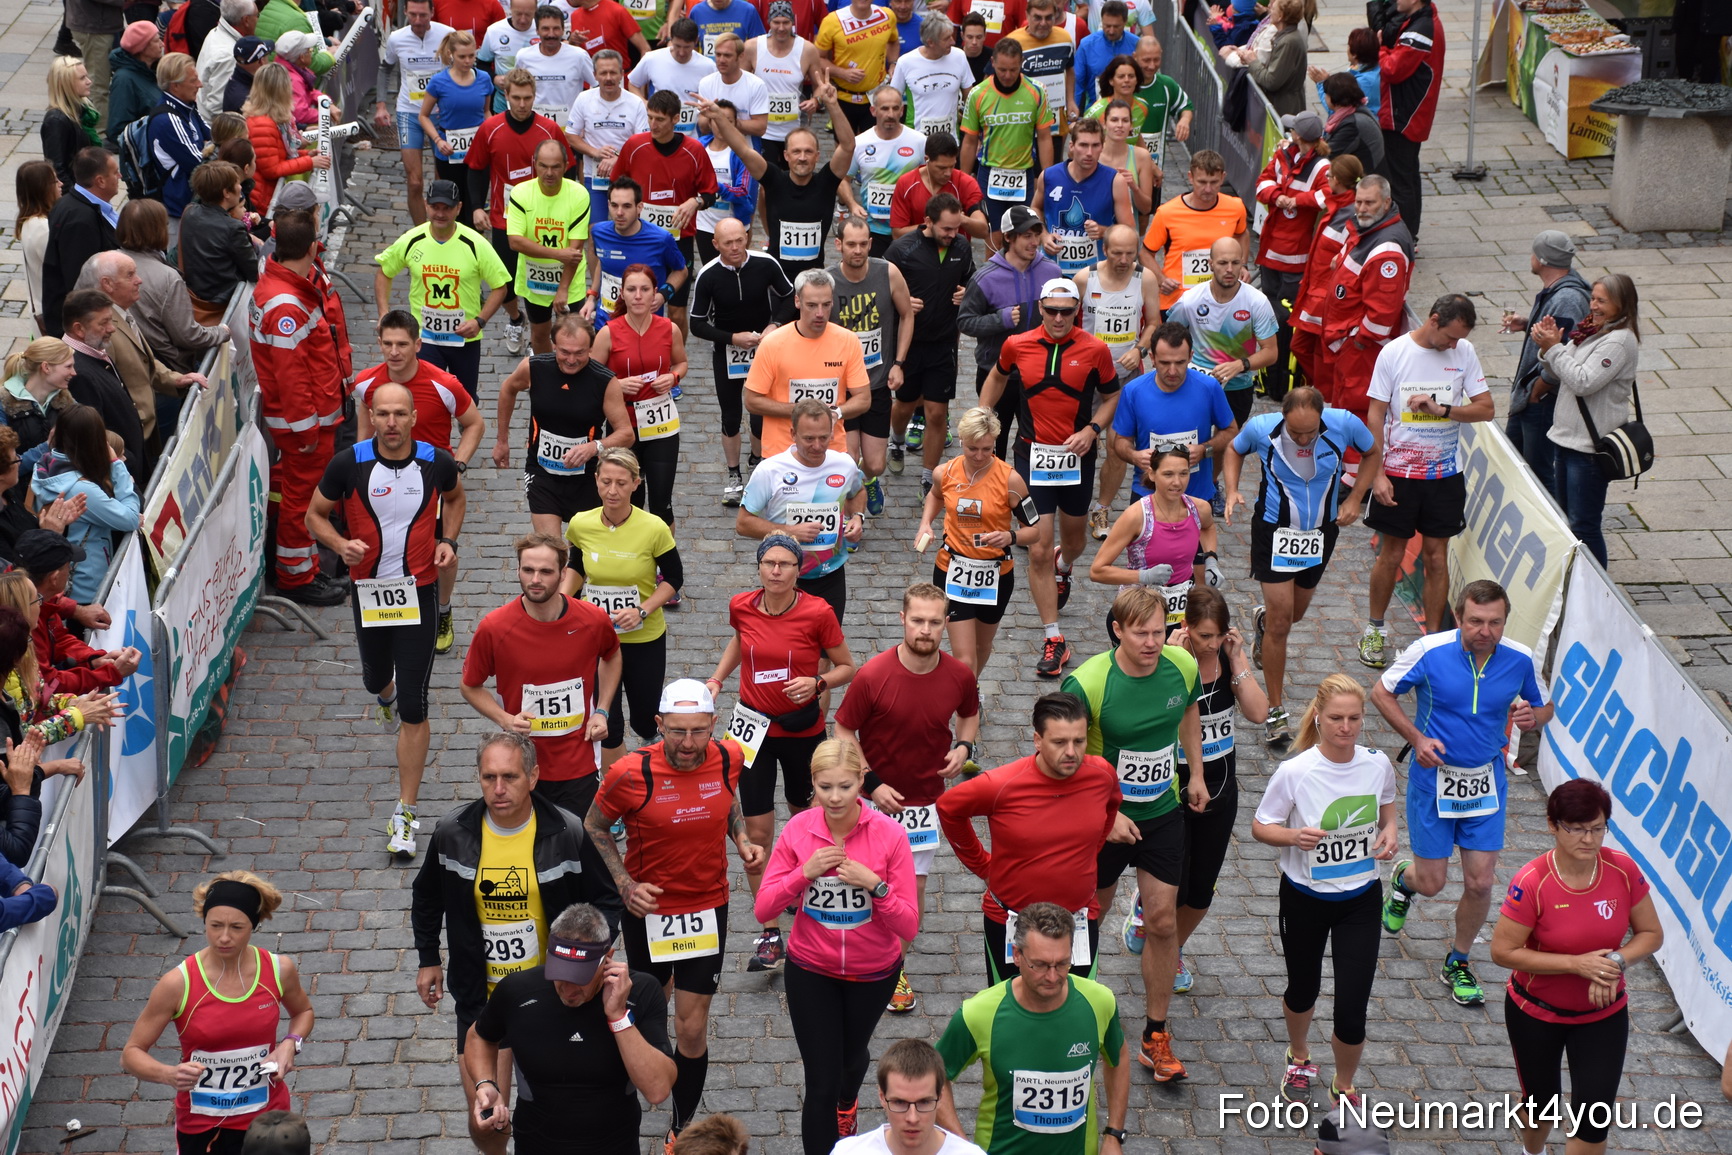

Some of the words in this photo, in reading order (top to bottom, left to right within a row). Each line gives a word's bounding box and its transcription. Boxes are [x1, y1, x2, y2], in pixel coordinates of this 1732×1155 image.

[846, 32, 868, 45] MAX
[870, 24, 891, 37] BÖGL
[1029, 58, 1063, 69] Fischer
[769, 100, 792, 113] 239
[320, 114, 330, 141] BMW
[451, 137, 472, 151] 204
[992, 173, 1023, 188] 2792
[871, 192, 893, 205] 227
[1049, 186, 1063, 202] 4
[535, 217, 565, 227] Müller
[648, 213, 673, 228] 289
[783, 230, 818, 246] 3111
[1061, 243, 1094, 260] 2092
[421, 263, 460, 275] Müller
[529, 268, 562, 284] 2390
[431, 283, 451, 299] M
[838, 282, 877, 305] RUN
[839, 302, 880, 323] THIS
[424, 316, 461, 332] 2818
[1104, 318, 1130, 332] 161
[731, 339, 756, 353] 224
[794, 378, 834, 394] 2529
[646, 404, 673, 425] 317
[1412, 413, 1442, 421] Matthias
[657, 426, 668, 434] Eva
[1036, 453, 1077, 469] 2570
[1047, 472, 1064, 480] Sven
[373, 486, 387, 494] tkn
[1278, 536, 1321, 556] 2626
[1287, 557, 1308, 567] Oliver
[952, 566, 996, 587] 2198
[371, 588, 407, 607] 103
[587, 588, 602, 596] PARTL
[960, 588, 981, 598] Maria
[592, 597, 636, 616] 2165
[378, 610, 403, 620] Henrik
[762, 672, 779, 680] DEHN
[544, 685, 574, 696] Neumarkt
[535, 695, 572, 717] 151
[1167, 694, 1184, 706] AOK
[735, 707, 761, 725] Neumarkt
[541, 719, 568, 729] Martin
[1120, 753, 1142, 762] PARTL
[1144, 751, 1170, 762] Neumarkt
[1122, 759, 1172, 783] 2368
[1438, 768, 1459, 777] PARTL
[1460, 768, 1488, 778] Neumarkt
[1130, 785, 1162, 796] Gerhard
[1443, 775, 1491, 798] 2638
[676, 806, 706, 815] Gruber
[1451, 800, 1482, 812] Michael
[1333, 830, 1366, 840] Neumarkt
[1316, 838, 1370, 864] 3021
[808, 887, 867, 910] 2215
[484, 901, 528, 911] HIRSCH
[820, 912, 854, 923] Natalie
[490, 927, 524, 937] Neumarkt
[660, 912, 704, 938] 215
[484, 938, 526, 962] 293
[672, 942, 697, 953] Reini
[491, 965, 523, 976] Robert
[1068, 1041, 1091, 1055] AOK
[192, 1055, 218, 1065] PARTL
[219, 1053, 258, 1064] Neumarkt
[199, 1061, 262, 1090] 2723
[1016, 1076, 1043, 1086] PARTL
[1044, 1076, 1081, 1086] Neumarkt
[210, 1094, 249, 1109] Simone
[1021, 1083, 1085, 1110] 2315
[1033, 1114, 1074, 1126] Thomas
